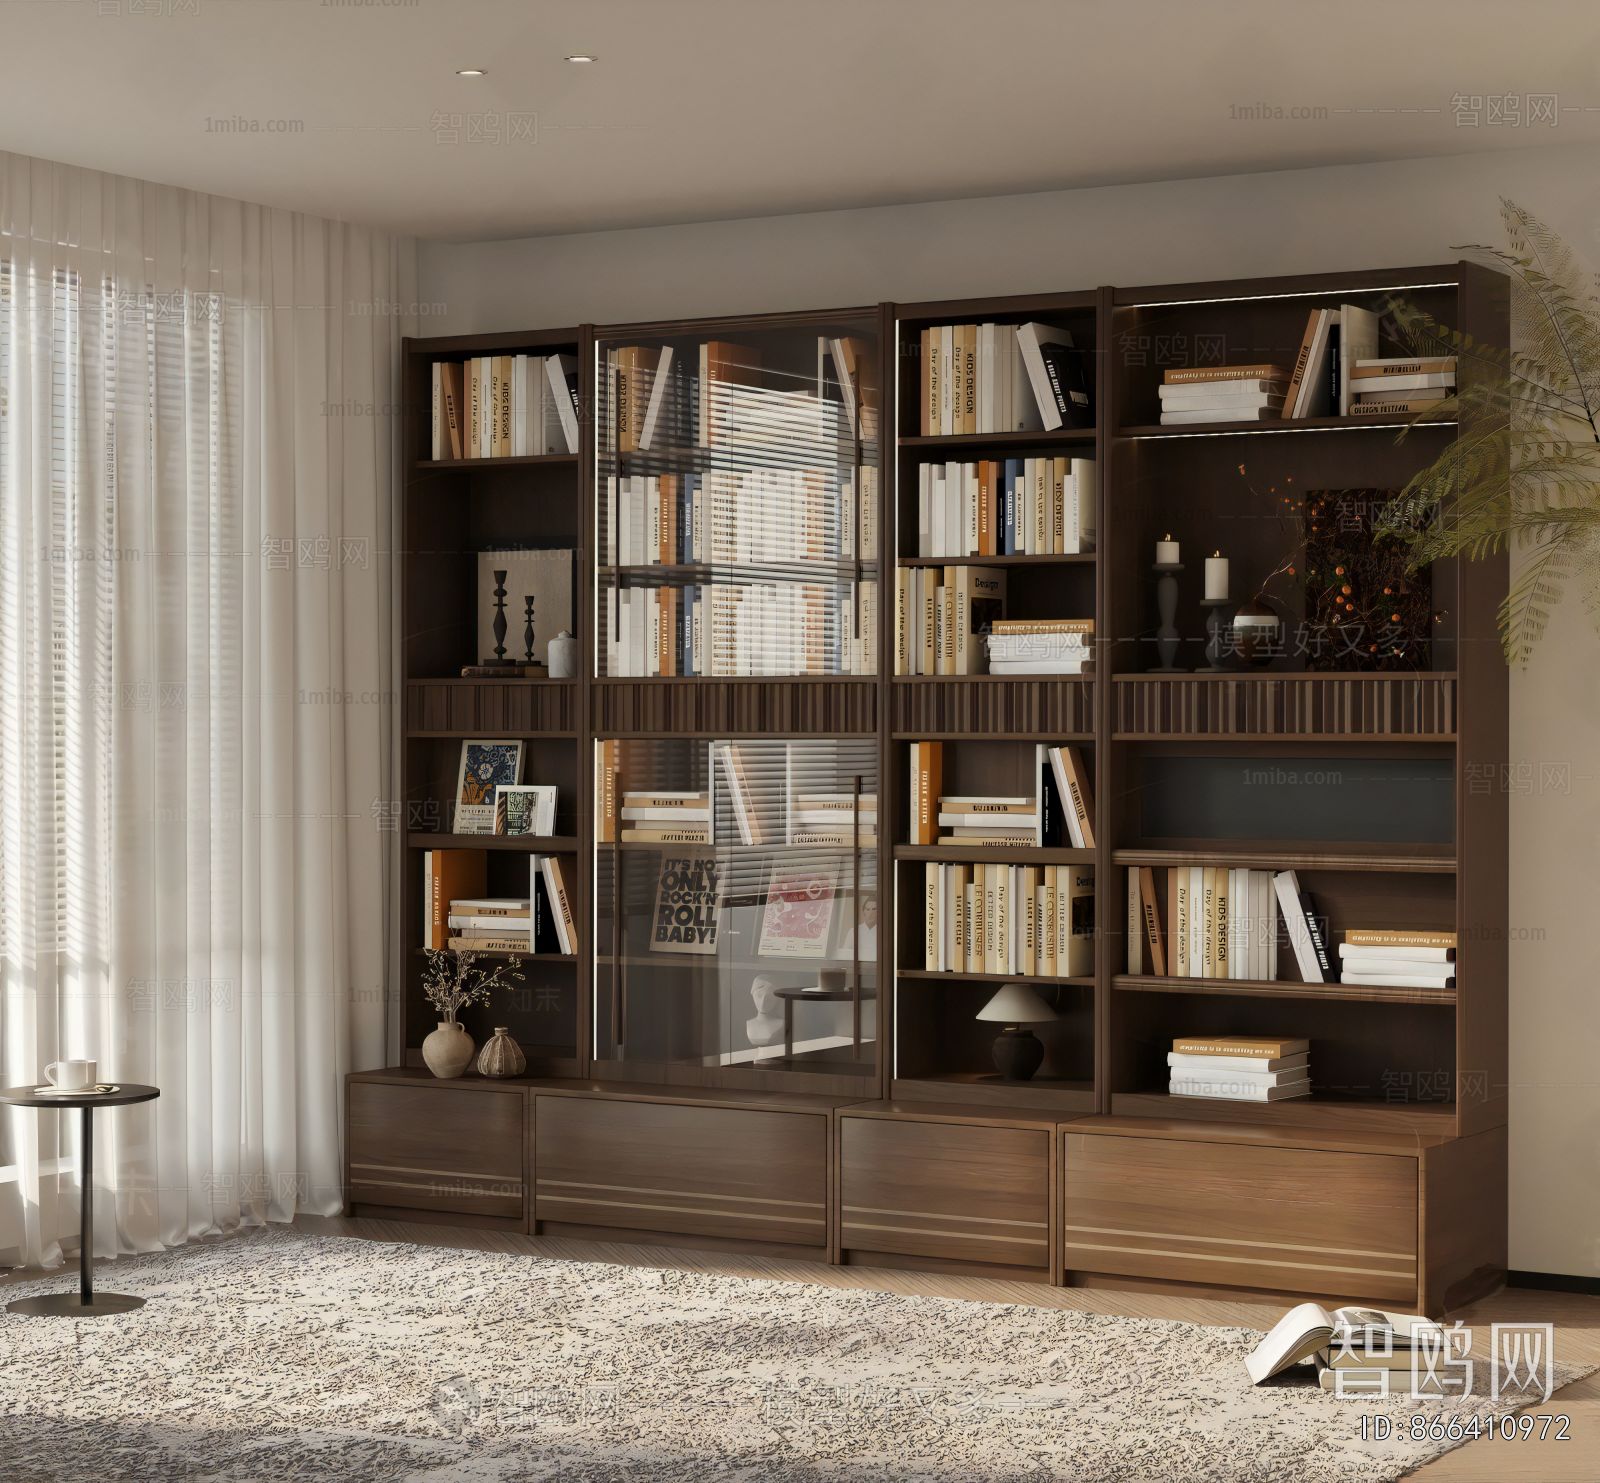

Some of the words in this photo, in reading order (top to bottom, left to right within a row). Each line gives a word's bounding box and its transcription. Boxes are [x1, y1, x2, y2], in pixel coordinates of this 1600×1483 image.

[660, 870, 719, 892] ONLY
[657, 904, 717, 927] ROLL
[655, 926, 716, 944] BABY!
